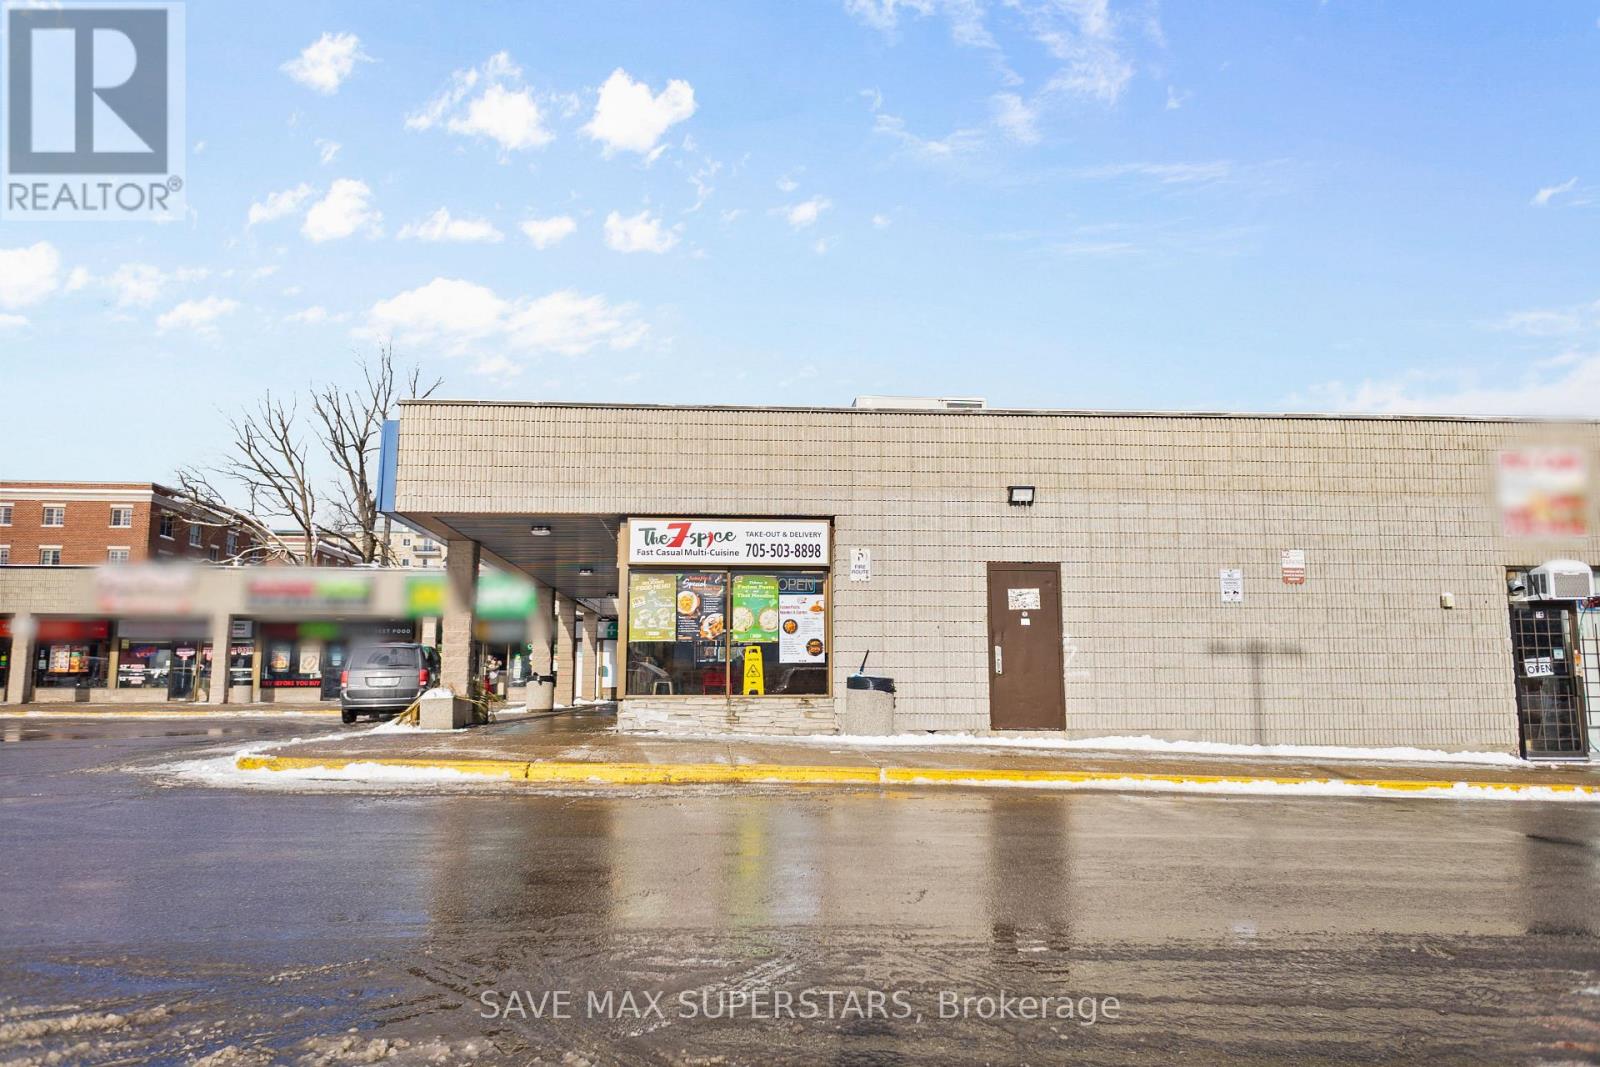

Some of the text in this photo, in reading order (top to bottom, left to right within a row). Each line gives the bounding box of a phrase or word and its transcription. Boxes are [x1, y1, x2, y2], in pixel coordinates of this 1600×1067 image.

[638, 522, 738, 549] The 7 spice
[636, 548, 740, 556] Fast Casual Multi-Cuisine
[745, 543, 821, 558] 705-503-8898
[778, 577, 814, 591] OPEN
[1527, 664, 1552, 674] OPEN
